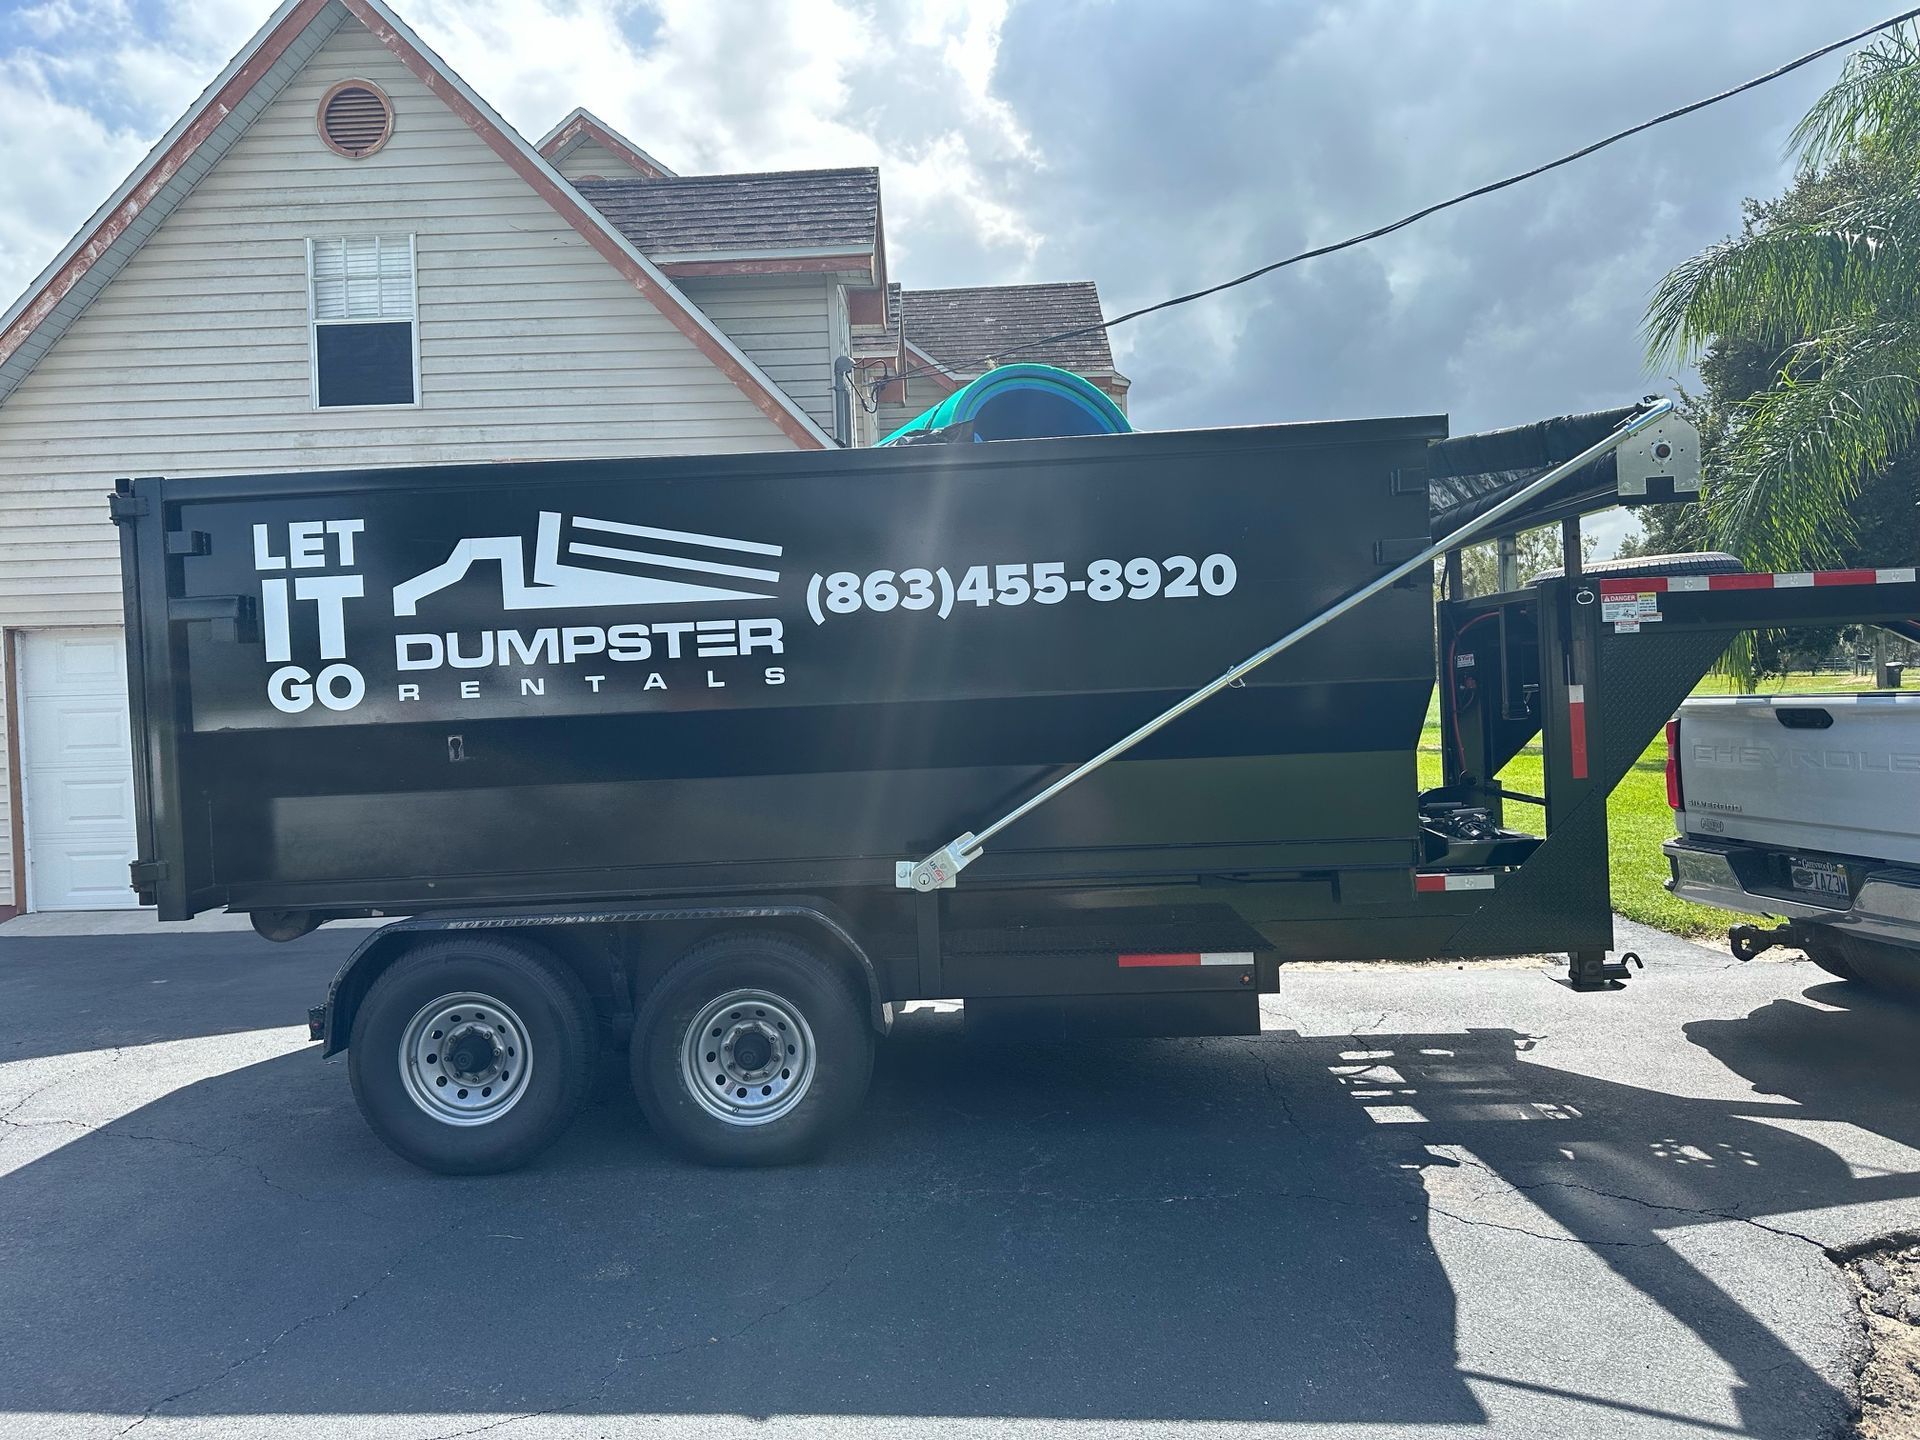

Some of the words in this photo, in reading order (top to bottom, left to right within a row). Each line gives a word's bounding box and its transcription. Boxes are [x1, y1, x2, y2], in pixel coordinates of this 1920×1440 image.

[252, 518, 365, 571] LET
[806, 553, 1237, 626] (863)455-8920
[261, 574, 365, 663] IT
[395, 618, 784, 671] DUMPSTER
[267, 663, 366, 713] GO
[398, 667, 786, 702] RENTALS
